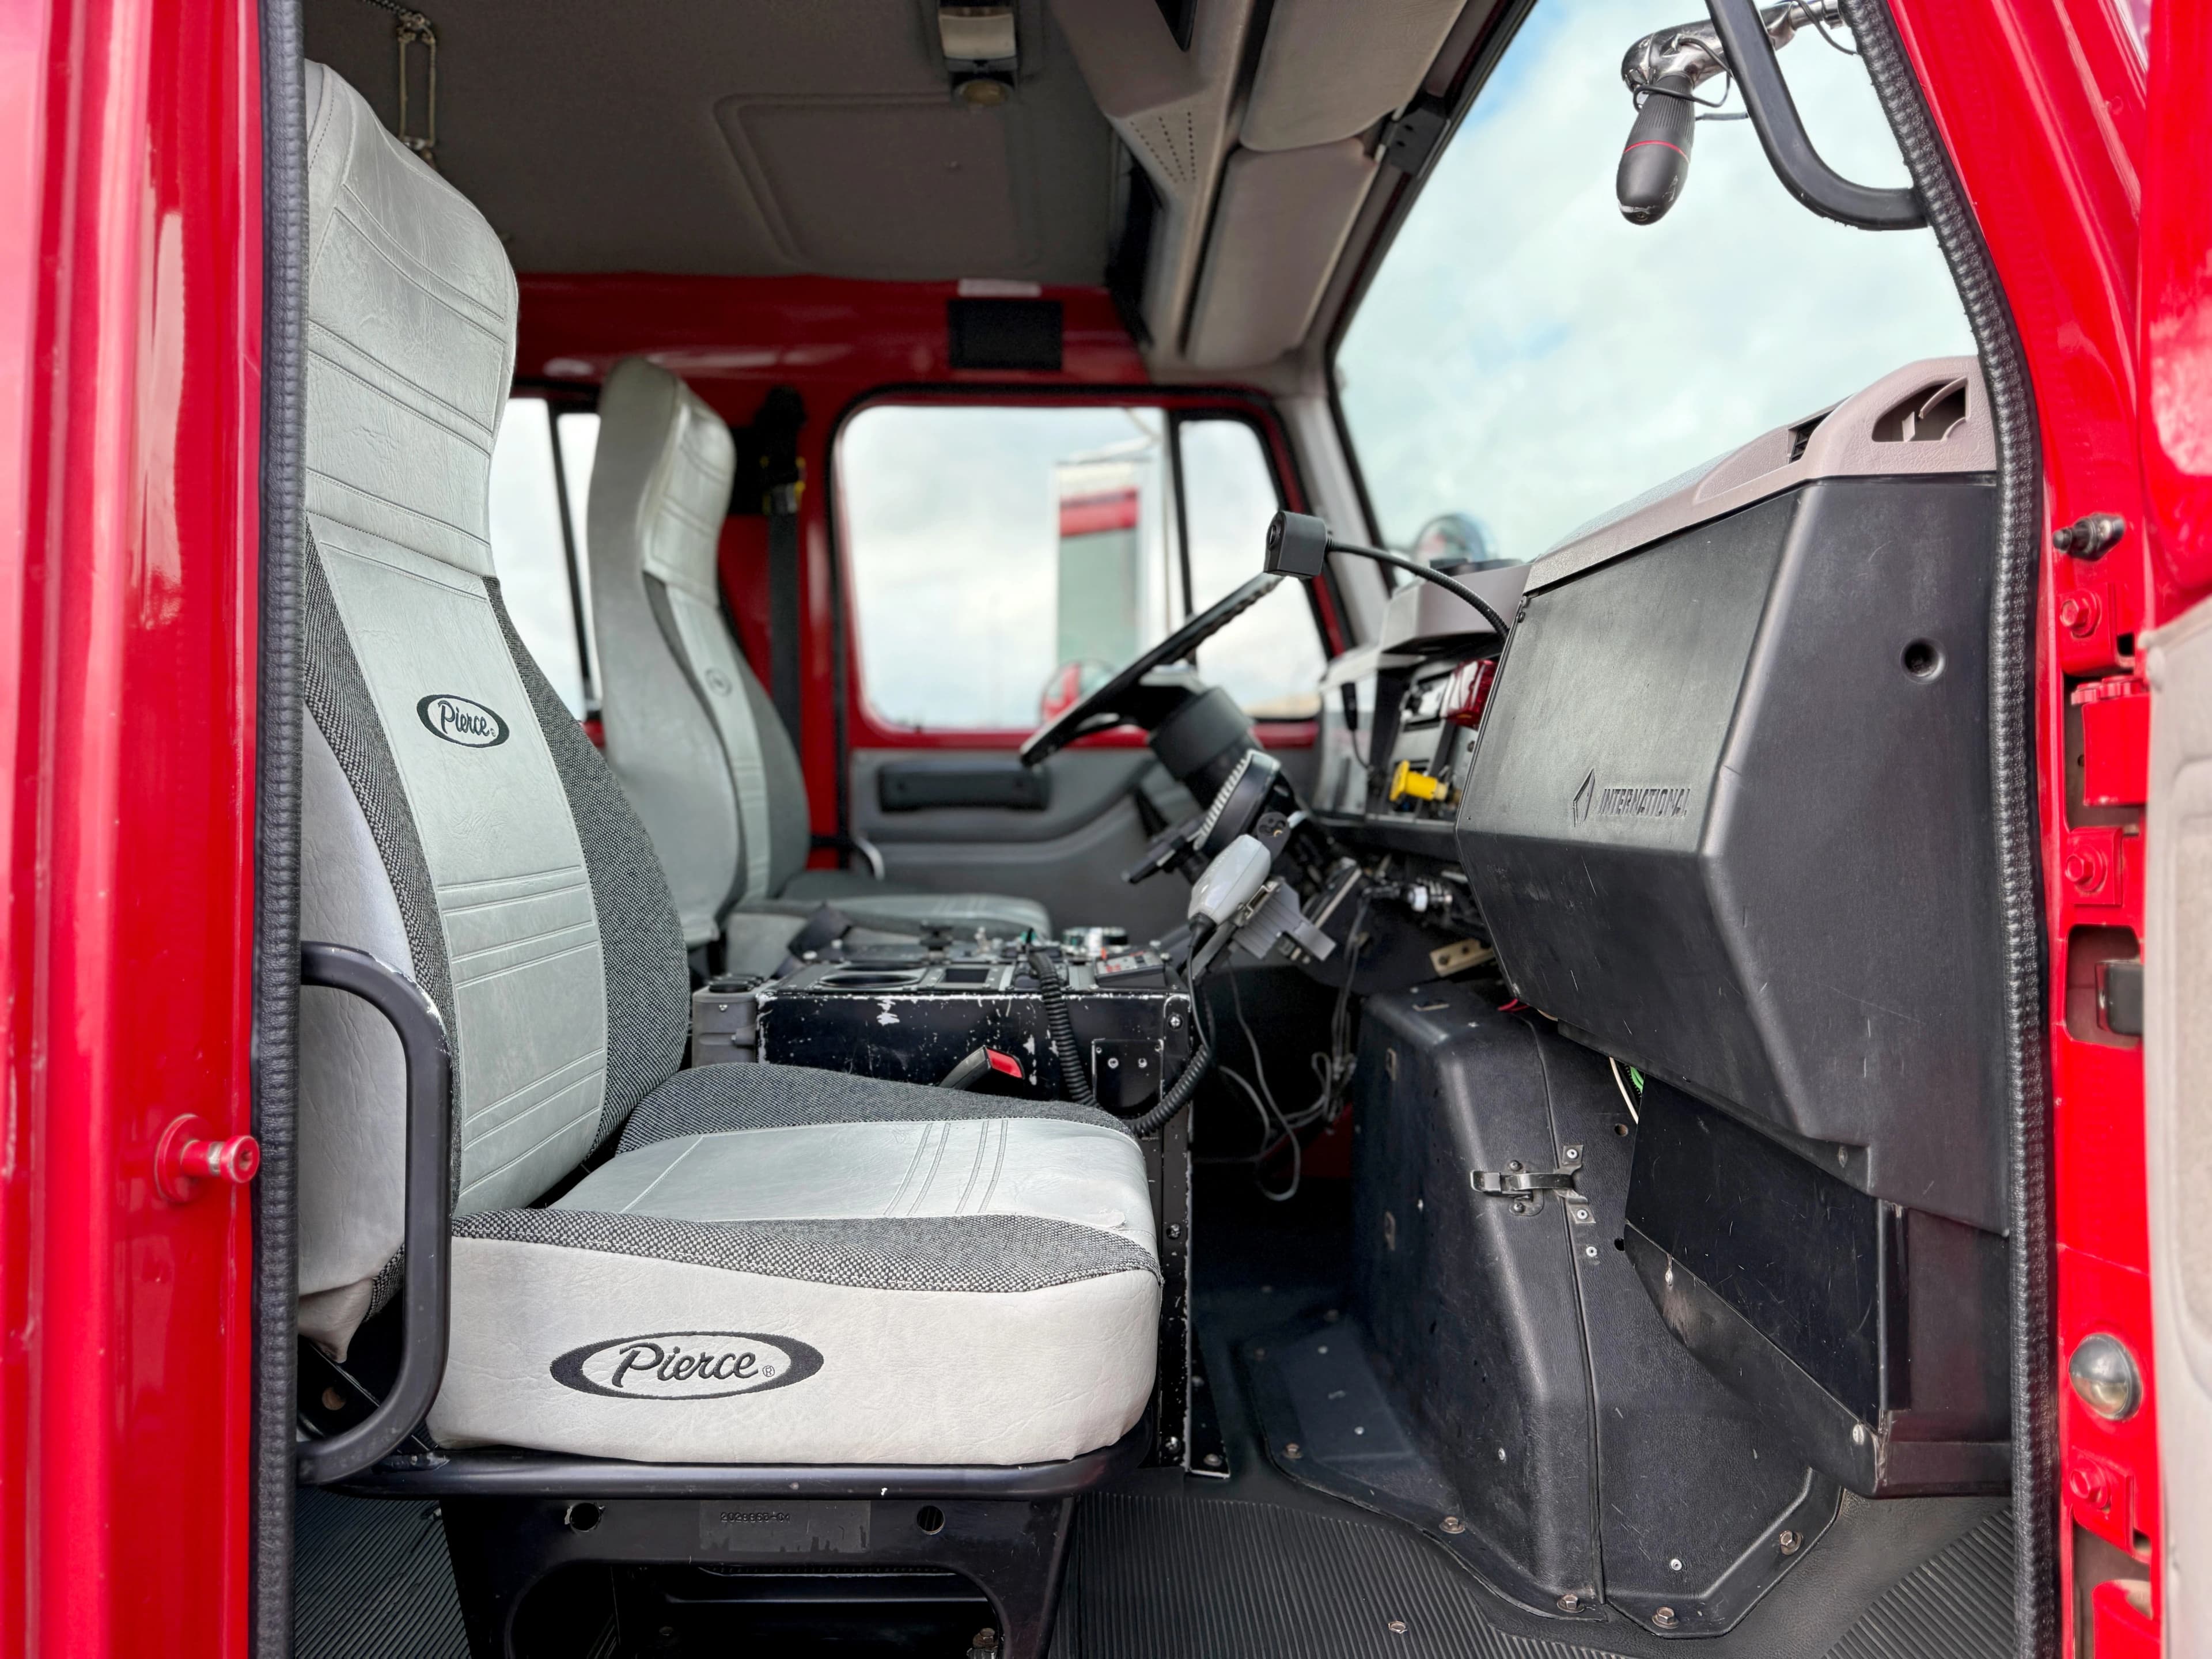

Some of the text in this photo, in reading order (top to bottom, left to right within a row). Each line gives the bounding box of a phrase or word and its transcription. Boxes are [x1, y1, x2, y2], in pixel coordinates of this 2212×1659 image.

[438, 700, 490, 736] Pierce
[1597, 788, 1691, 817] INTERNATIONAL
[612, 1342, 759, 1388] Pierce
